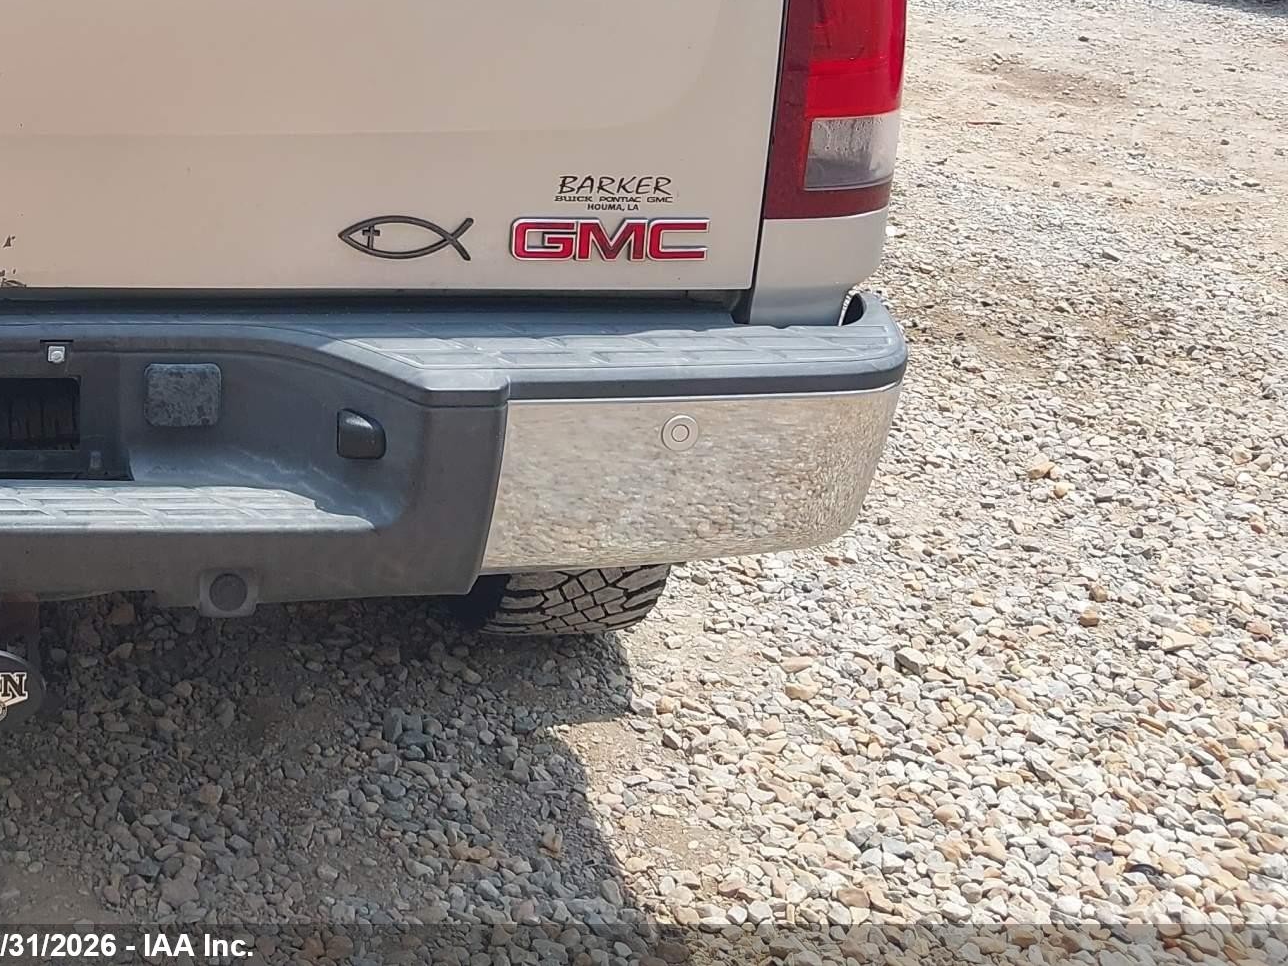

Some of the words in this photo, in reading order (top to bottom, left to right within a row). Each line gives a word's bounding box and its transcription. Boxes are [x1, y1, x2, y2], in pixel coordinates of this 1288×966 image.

[558, 174, 672, 196] BARKER
[587, 203, 625, 211] HOUMA,
[627, 203, 639, 211] LA
[511, 218, 709, 262] GMC
